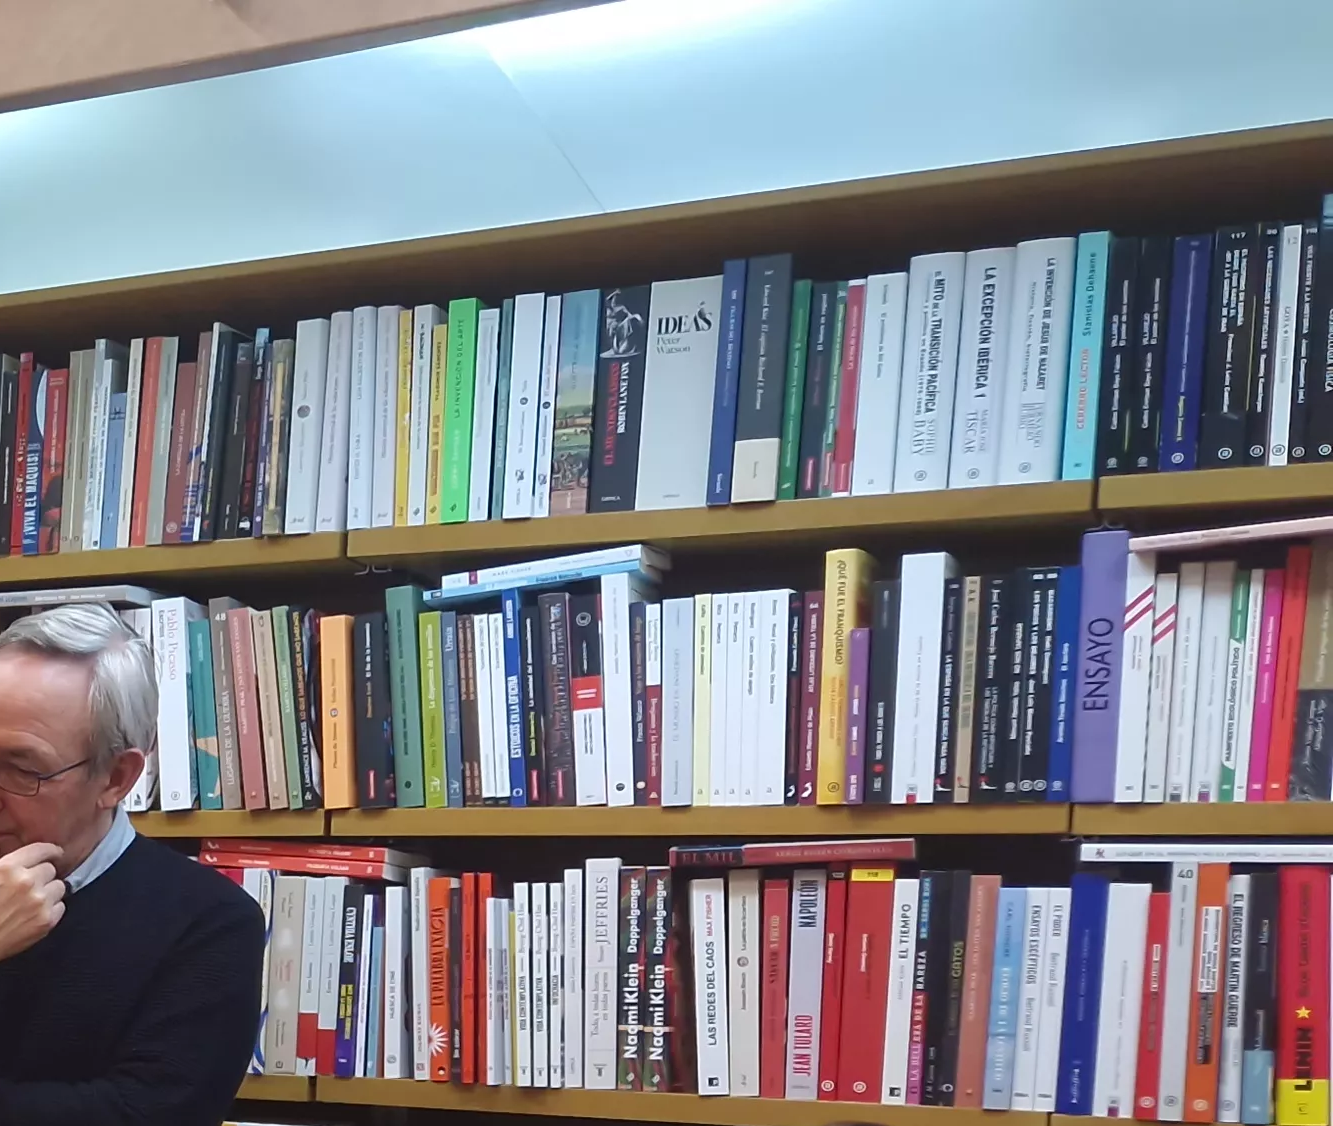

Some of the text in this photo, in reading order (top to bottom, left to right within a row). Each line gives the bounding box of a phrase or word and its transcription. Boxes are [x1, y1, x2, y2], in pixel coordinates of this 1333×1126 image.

[933, 278, 945, 301] MITO
[984, 267, 996, 281] LA
[656, 300, 713, 336] IDEAS
[978, 283, 995, 344] EXCEPCIÓN
[656, 336, 681, 346] Peter
[927, 318, 943, 371] TRANSICIÓN
[975, 347, 992, 390] IBÉRICA
[925, 373, 939, 413] PACÍFICA
[912, 420, 925, 455] BABY
[23, 508, 36, 535] ¡VIVA
[25, 496, 37, 507] EL
[836, 598, 844, 607] EL
[837, 580, 846, 596] FUE
[167, 608, 177, 680] Pablo Picasso
[833, 608, 844, 665] FRANQUISMO?
[1082, 617, 1114, 711] ENSAYO
[223, 737, 232, 748] DE
[796, 880, 819, 928] NAPOLEÓN
[1031, 905, 1042, 936] ENSAYOS
[899, 904, 911, 959] EL TIEMPO
[623, 877, 641, 1058] Naomi Klein Doppelganger
[648, 879, 667, 1060] Naomi Klein Doppelganger
[704, 894, 717, 1046] LAS REDES DEL CAOS MAX FISHER
[951, 940, 963, 977] GATOS
[793, 1014, 812, 1077] JEAN TULARD
[1294, 1027, 1313, 1091] LENIN
